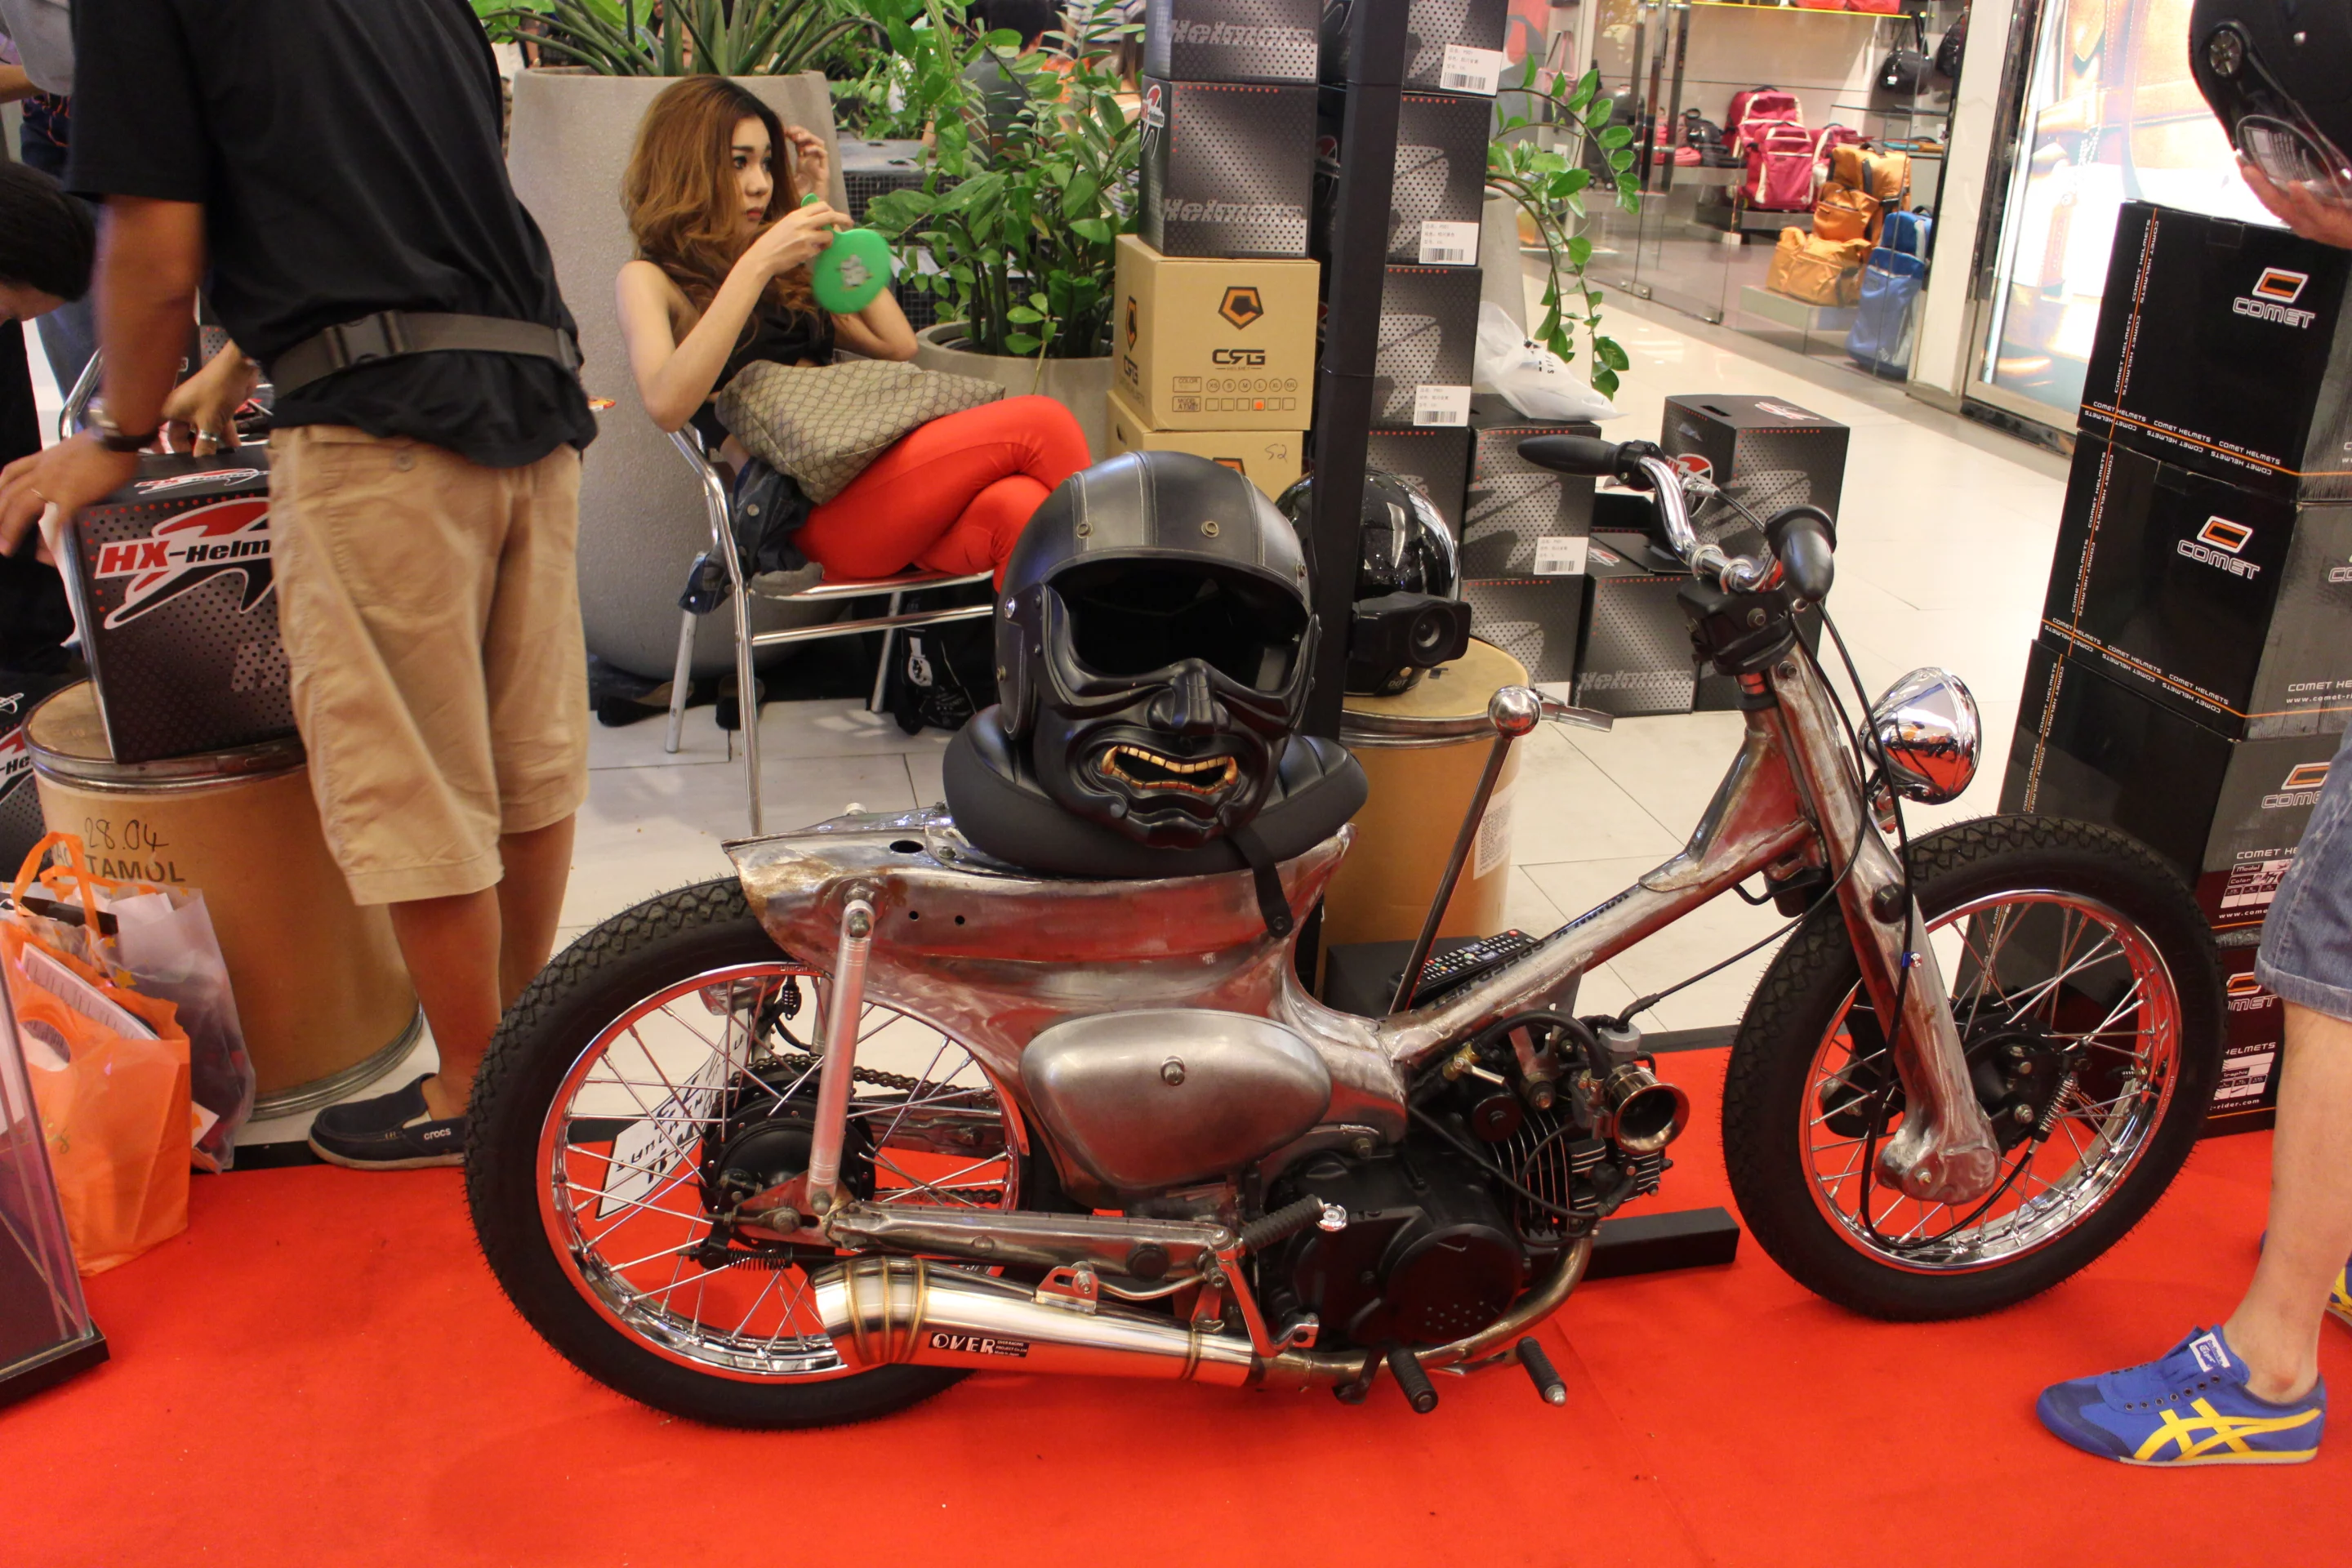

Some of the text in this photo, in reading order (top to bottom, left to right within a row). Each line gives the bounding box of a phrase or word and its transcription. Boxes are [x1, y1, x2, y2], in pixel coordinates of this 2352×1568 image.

[1170, 20, 1314, 44] Helmets
[1165, 199, 1303, 222] Helmets
[2132, 219, 2151, 301] COMET HELMETS
[2140, 220, 2159, 303] COMET HELMETS
[2233, 297, 2316, 328] COMET
[2114, 314, 2132, 393] COMET HELMETS
[2123, 315, 2140, 395] COMET HELMETS
[2084, 410, 2137, 431] COMET HELMETS
[2093, 401, 2146, 422] COMET HELMETS
[2146, 430, 2204, 453] COMET HELMETS
[2154, 420, 2212, 443] COMET HELMETS
[2210, 451, 2272, 475] COMET HELMETS
[2219, 440, 2281, 465] COMET HELMETS
[2087, 452, 2106, 528] COMET HELMETS
[2095, 455, 2114, 532] COMET HELMETS
[2177, 540, 2261, 580] COMET
[2071, 539, 2089, 613] COMET HELMETS
[2078, 542, 2096, 617] COMET HELMETS
[2044, 625, 2093, 653] COMET HELMETS
[2052, 617, 2101, 645] COMET HELMETS
[2102, 653, 2155, 683] COMET HELMETS
[2108, 644, 2162, 674] COMET HELMETS
[2038, 662, 2057, 733] COMET HELMETS
[2045, 666, 2065, 737] COMET HELMETS
[2162, 683, 2221, 714] COMET HELMETS
[2169, 674, 2229, 705] COMET HELMETS
[2288, 681, 2332, 692] COMET
[2029, 743, 2039, 782] HELMETS
[2038, 747, 2046, 776] COMET
[2236, 849, 2282, 859] COMET
[2237, 864, 2260, 872] Model
[424, 1128, 452, 1141] crocs
[932, 1334, 996, 1355] OVER
